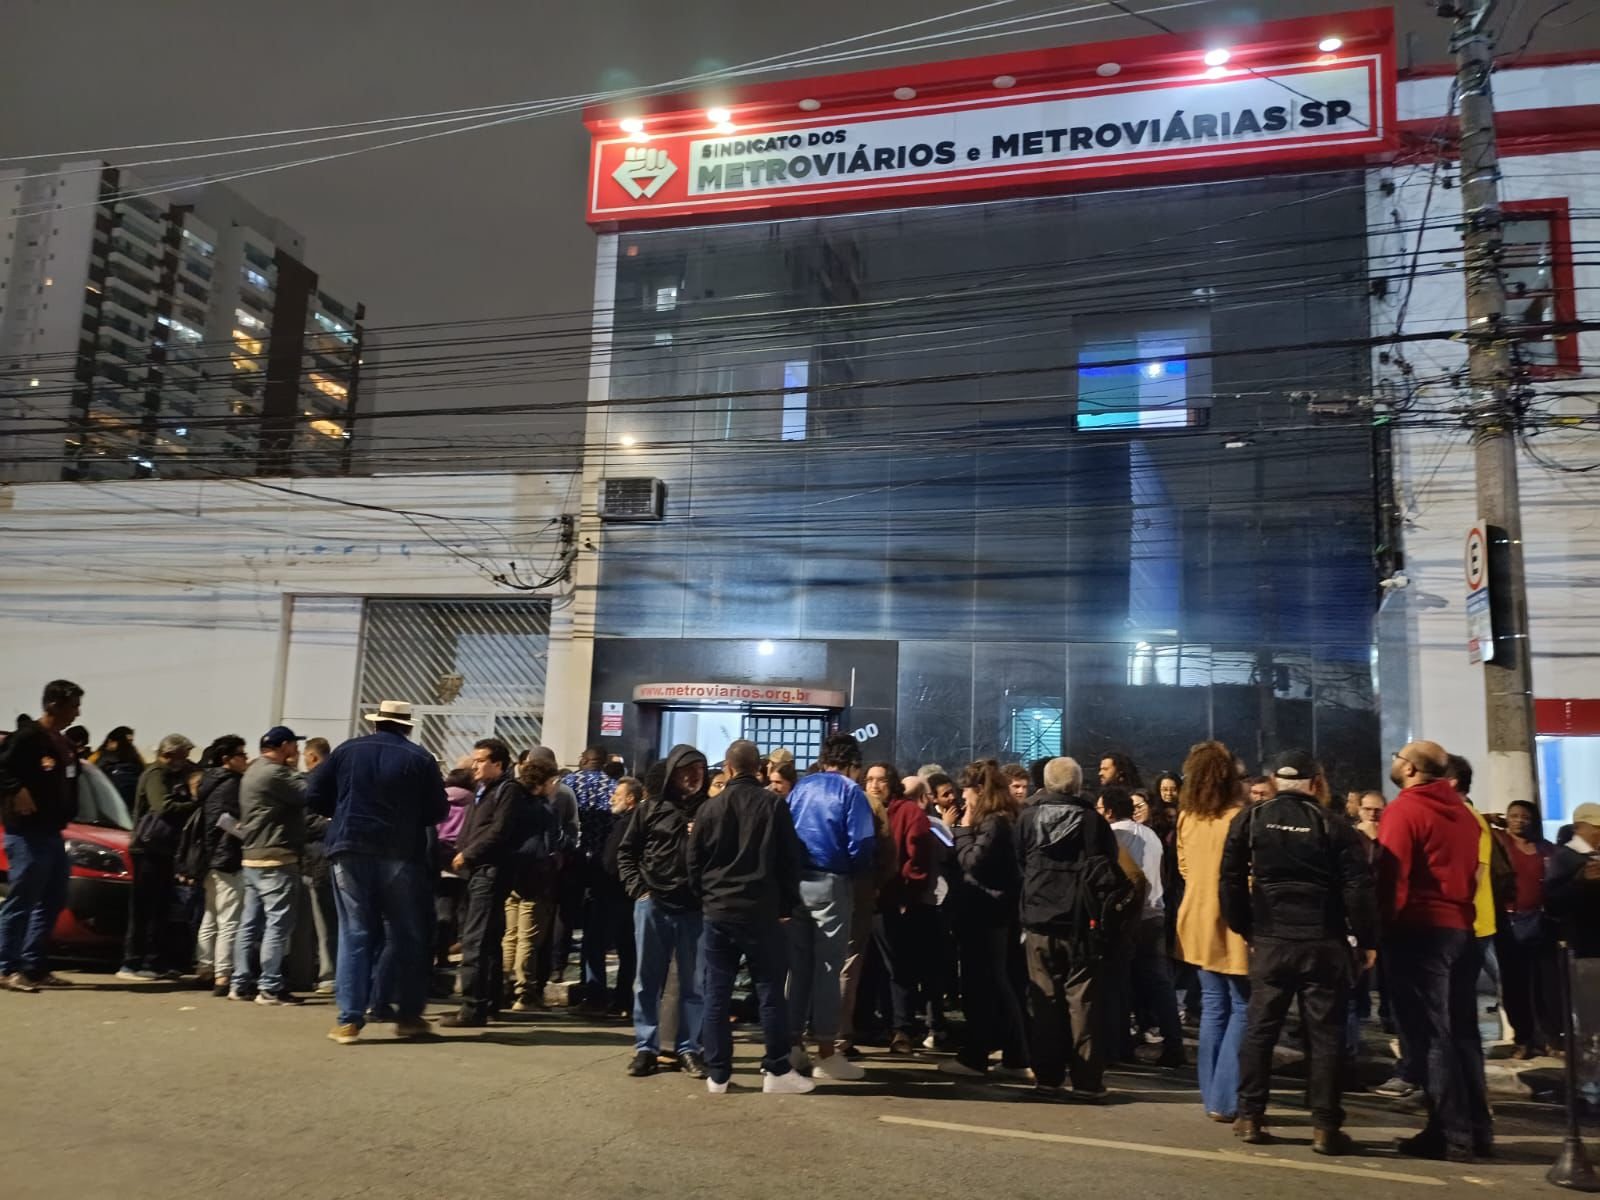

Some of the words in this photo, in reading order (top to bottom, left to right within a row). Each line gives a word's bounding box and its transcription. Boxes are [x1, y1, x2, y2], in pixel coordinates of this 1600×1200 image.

[697, 142, 955, 191] METROVIÁRIOS
[967, 146, 980, 161] e
[992, 106, 1287, 159] METROVIÁRIAS
[701, 134, 801, 158] SINDICATO
[807, 129, 847, 146] DOS
[640, 684, 811, 703] www.metroviarios.org.br
[849, 723, 879, 743] 00
